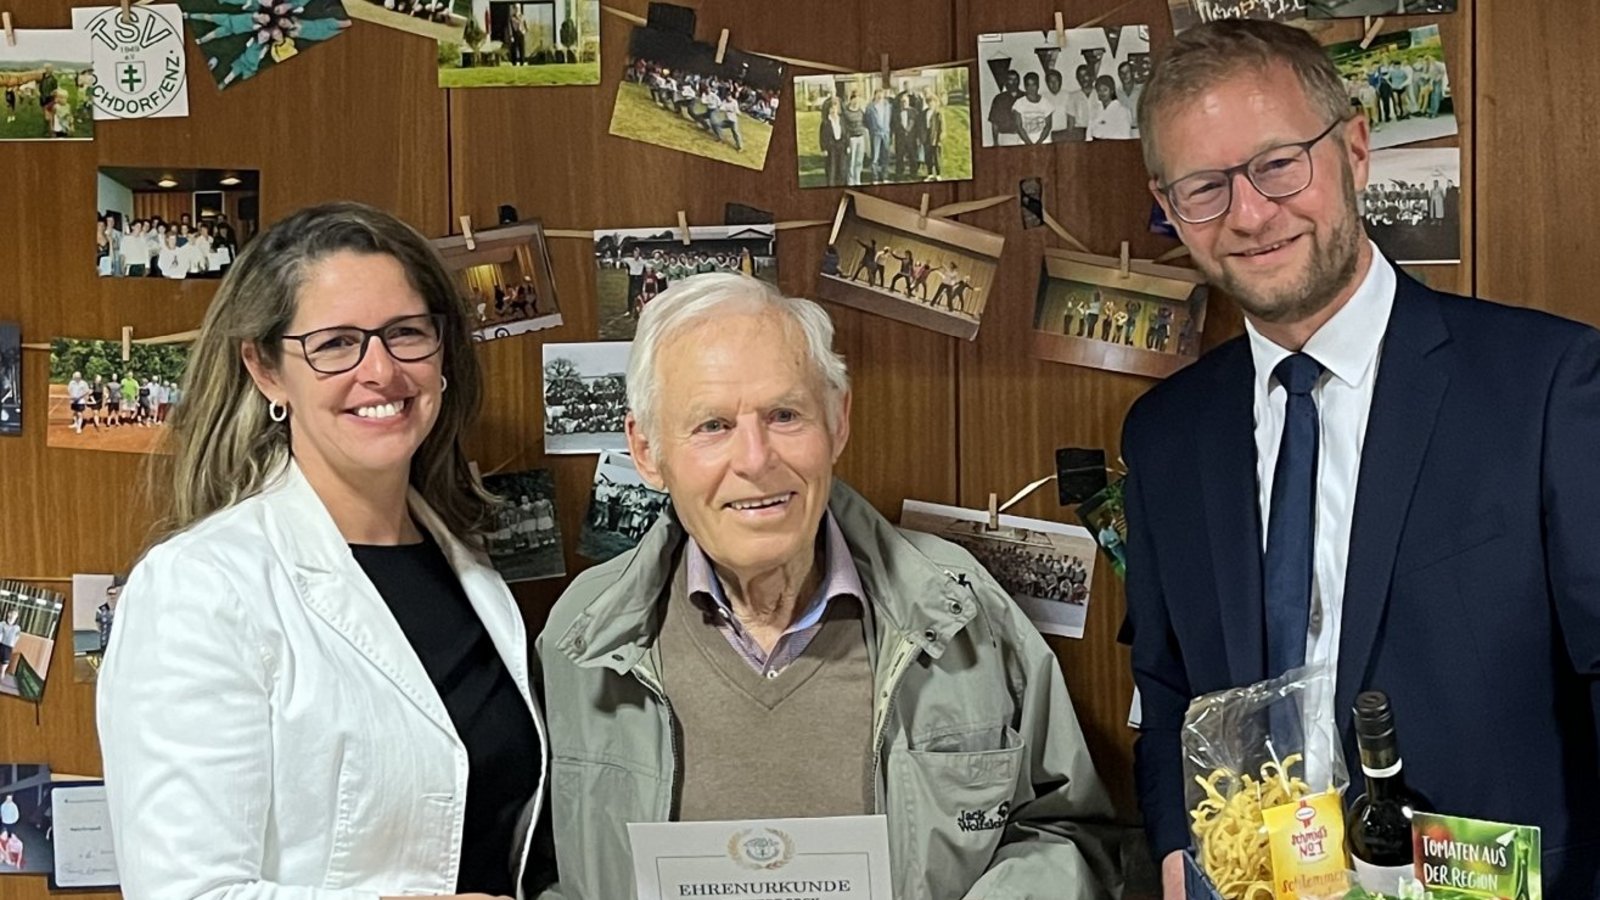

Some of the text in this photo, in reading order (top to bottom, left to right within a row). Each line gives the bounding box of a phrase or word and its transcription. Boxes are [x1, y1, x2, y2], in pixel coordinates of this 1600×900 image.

[91, 10, 172, 51] TSV
[958, 809, 986, 821] Jack
[1421, 835, 1507, 868] TOMATEN AUS
[678, 879, 851, 897] EHRENURKUNDE
[1423, 862, 1498, 891] DER REGION
